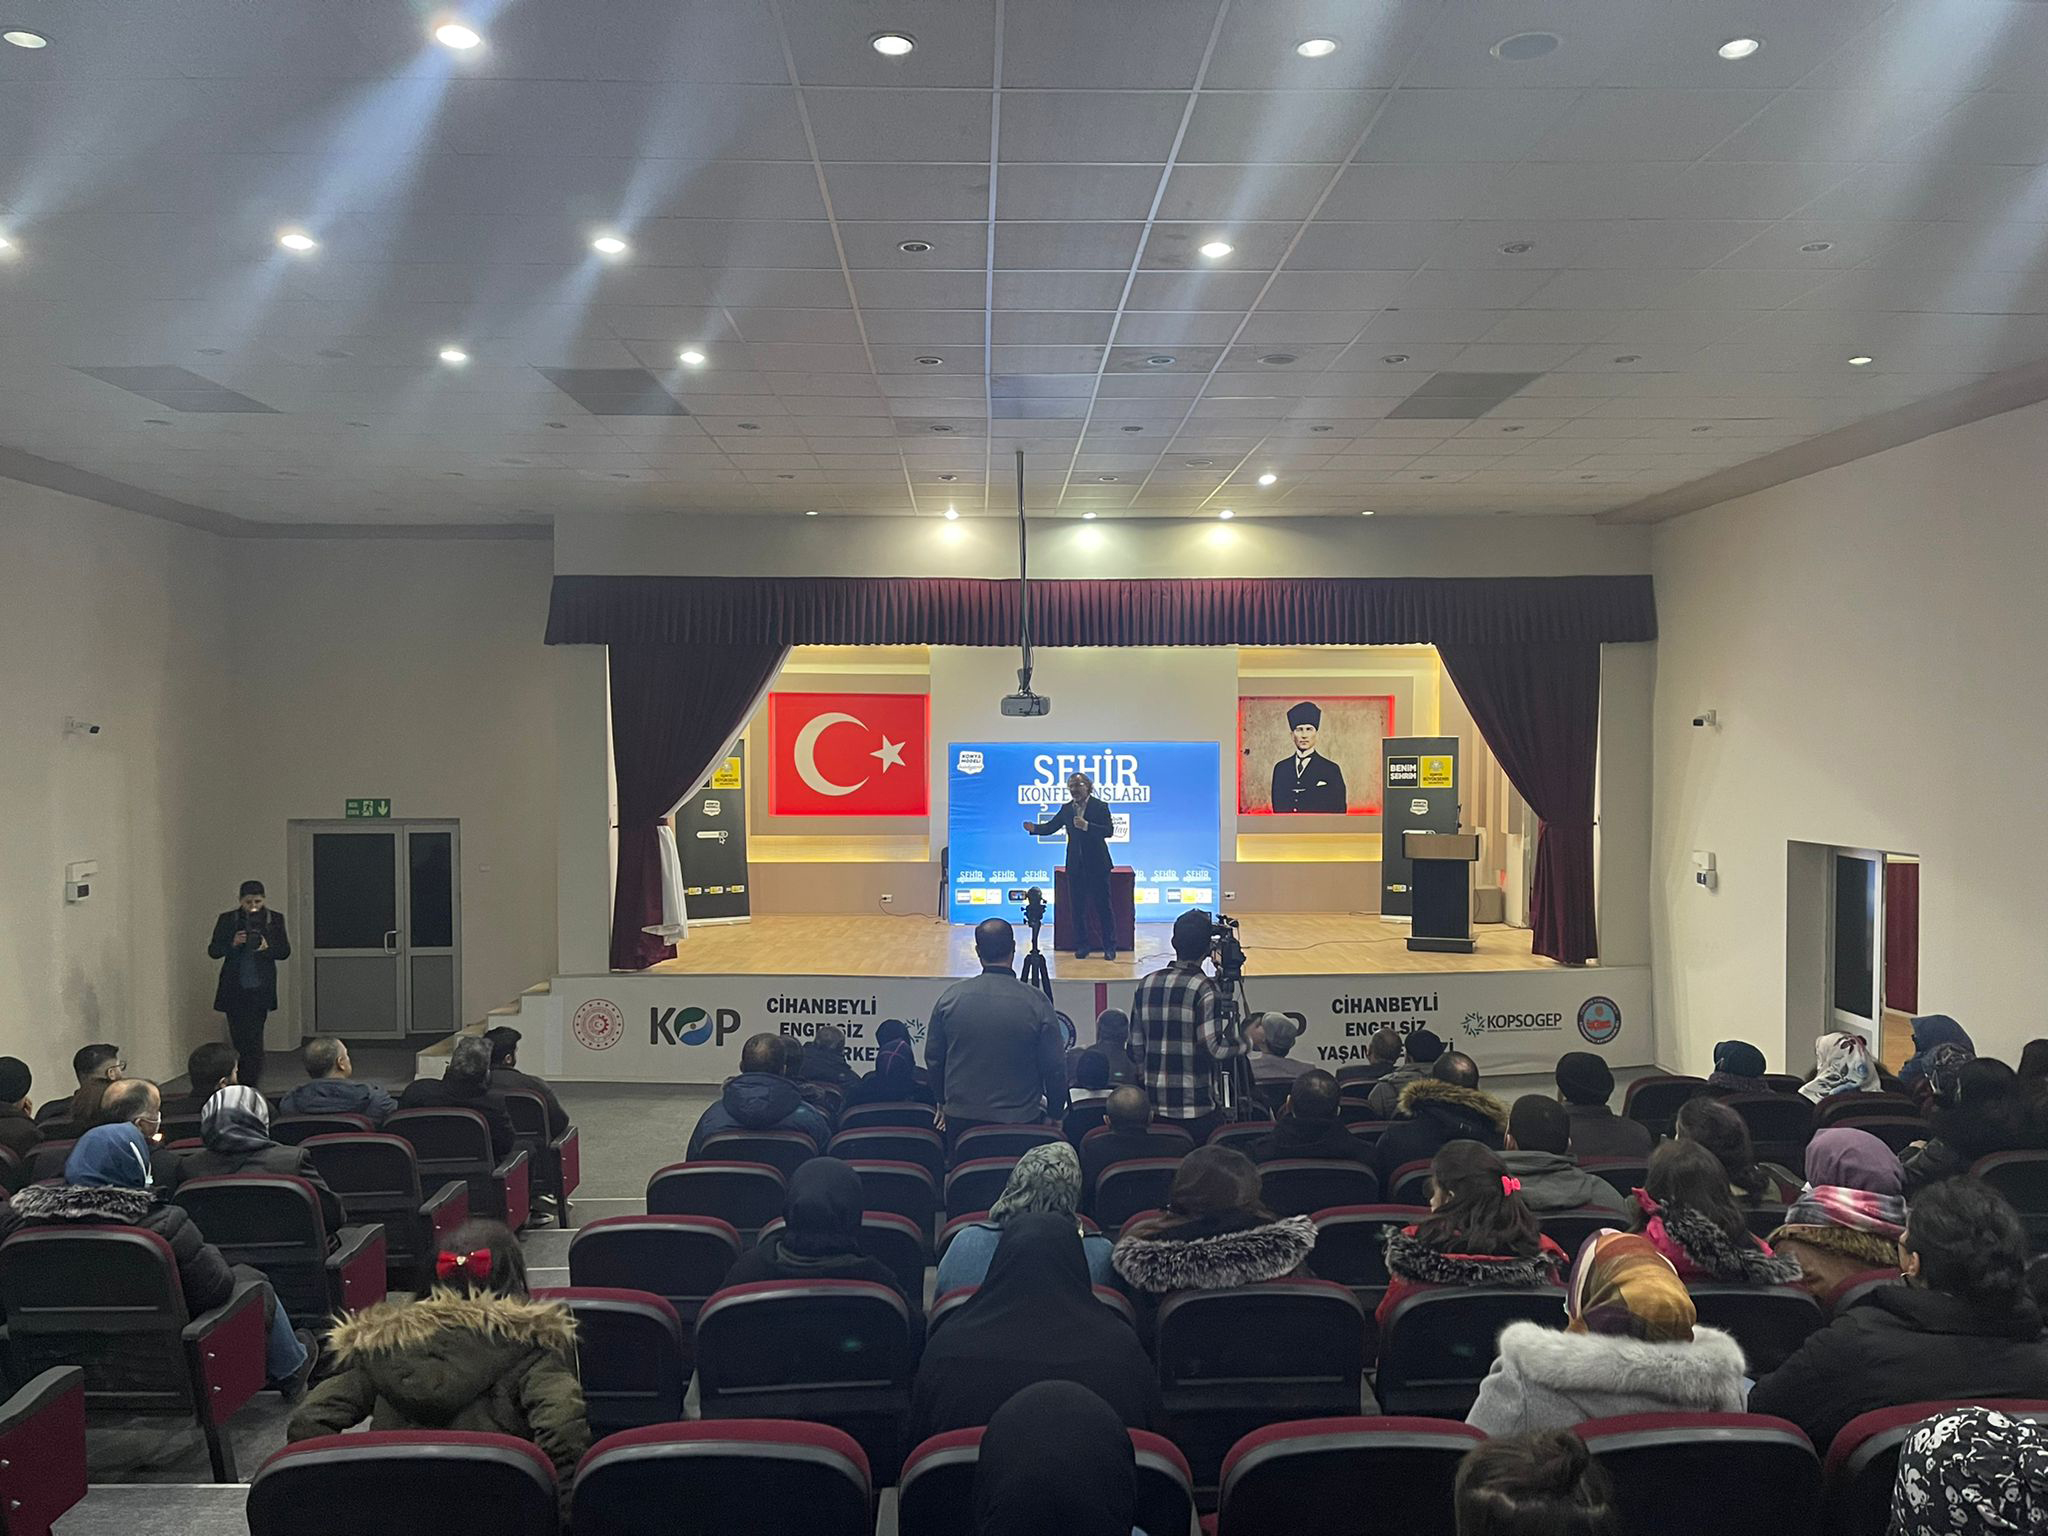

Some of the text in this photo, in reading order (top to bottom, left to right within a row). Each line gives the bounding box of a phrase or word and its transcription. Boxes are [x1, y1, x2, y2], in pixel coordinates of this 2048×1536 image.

[766, 993, 877, 1015] CİHANBEYLİ
[1332, 992, 1439, 1014] CİHANBEYLİ
[650, 1006, 741, 1047] KOP
[1487, 1013, 1562, 1028] KOPSOGEP
